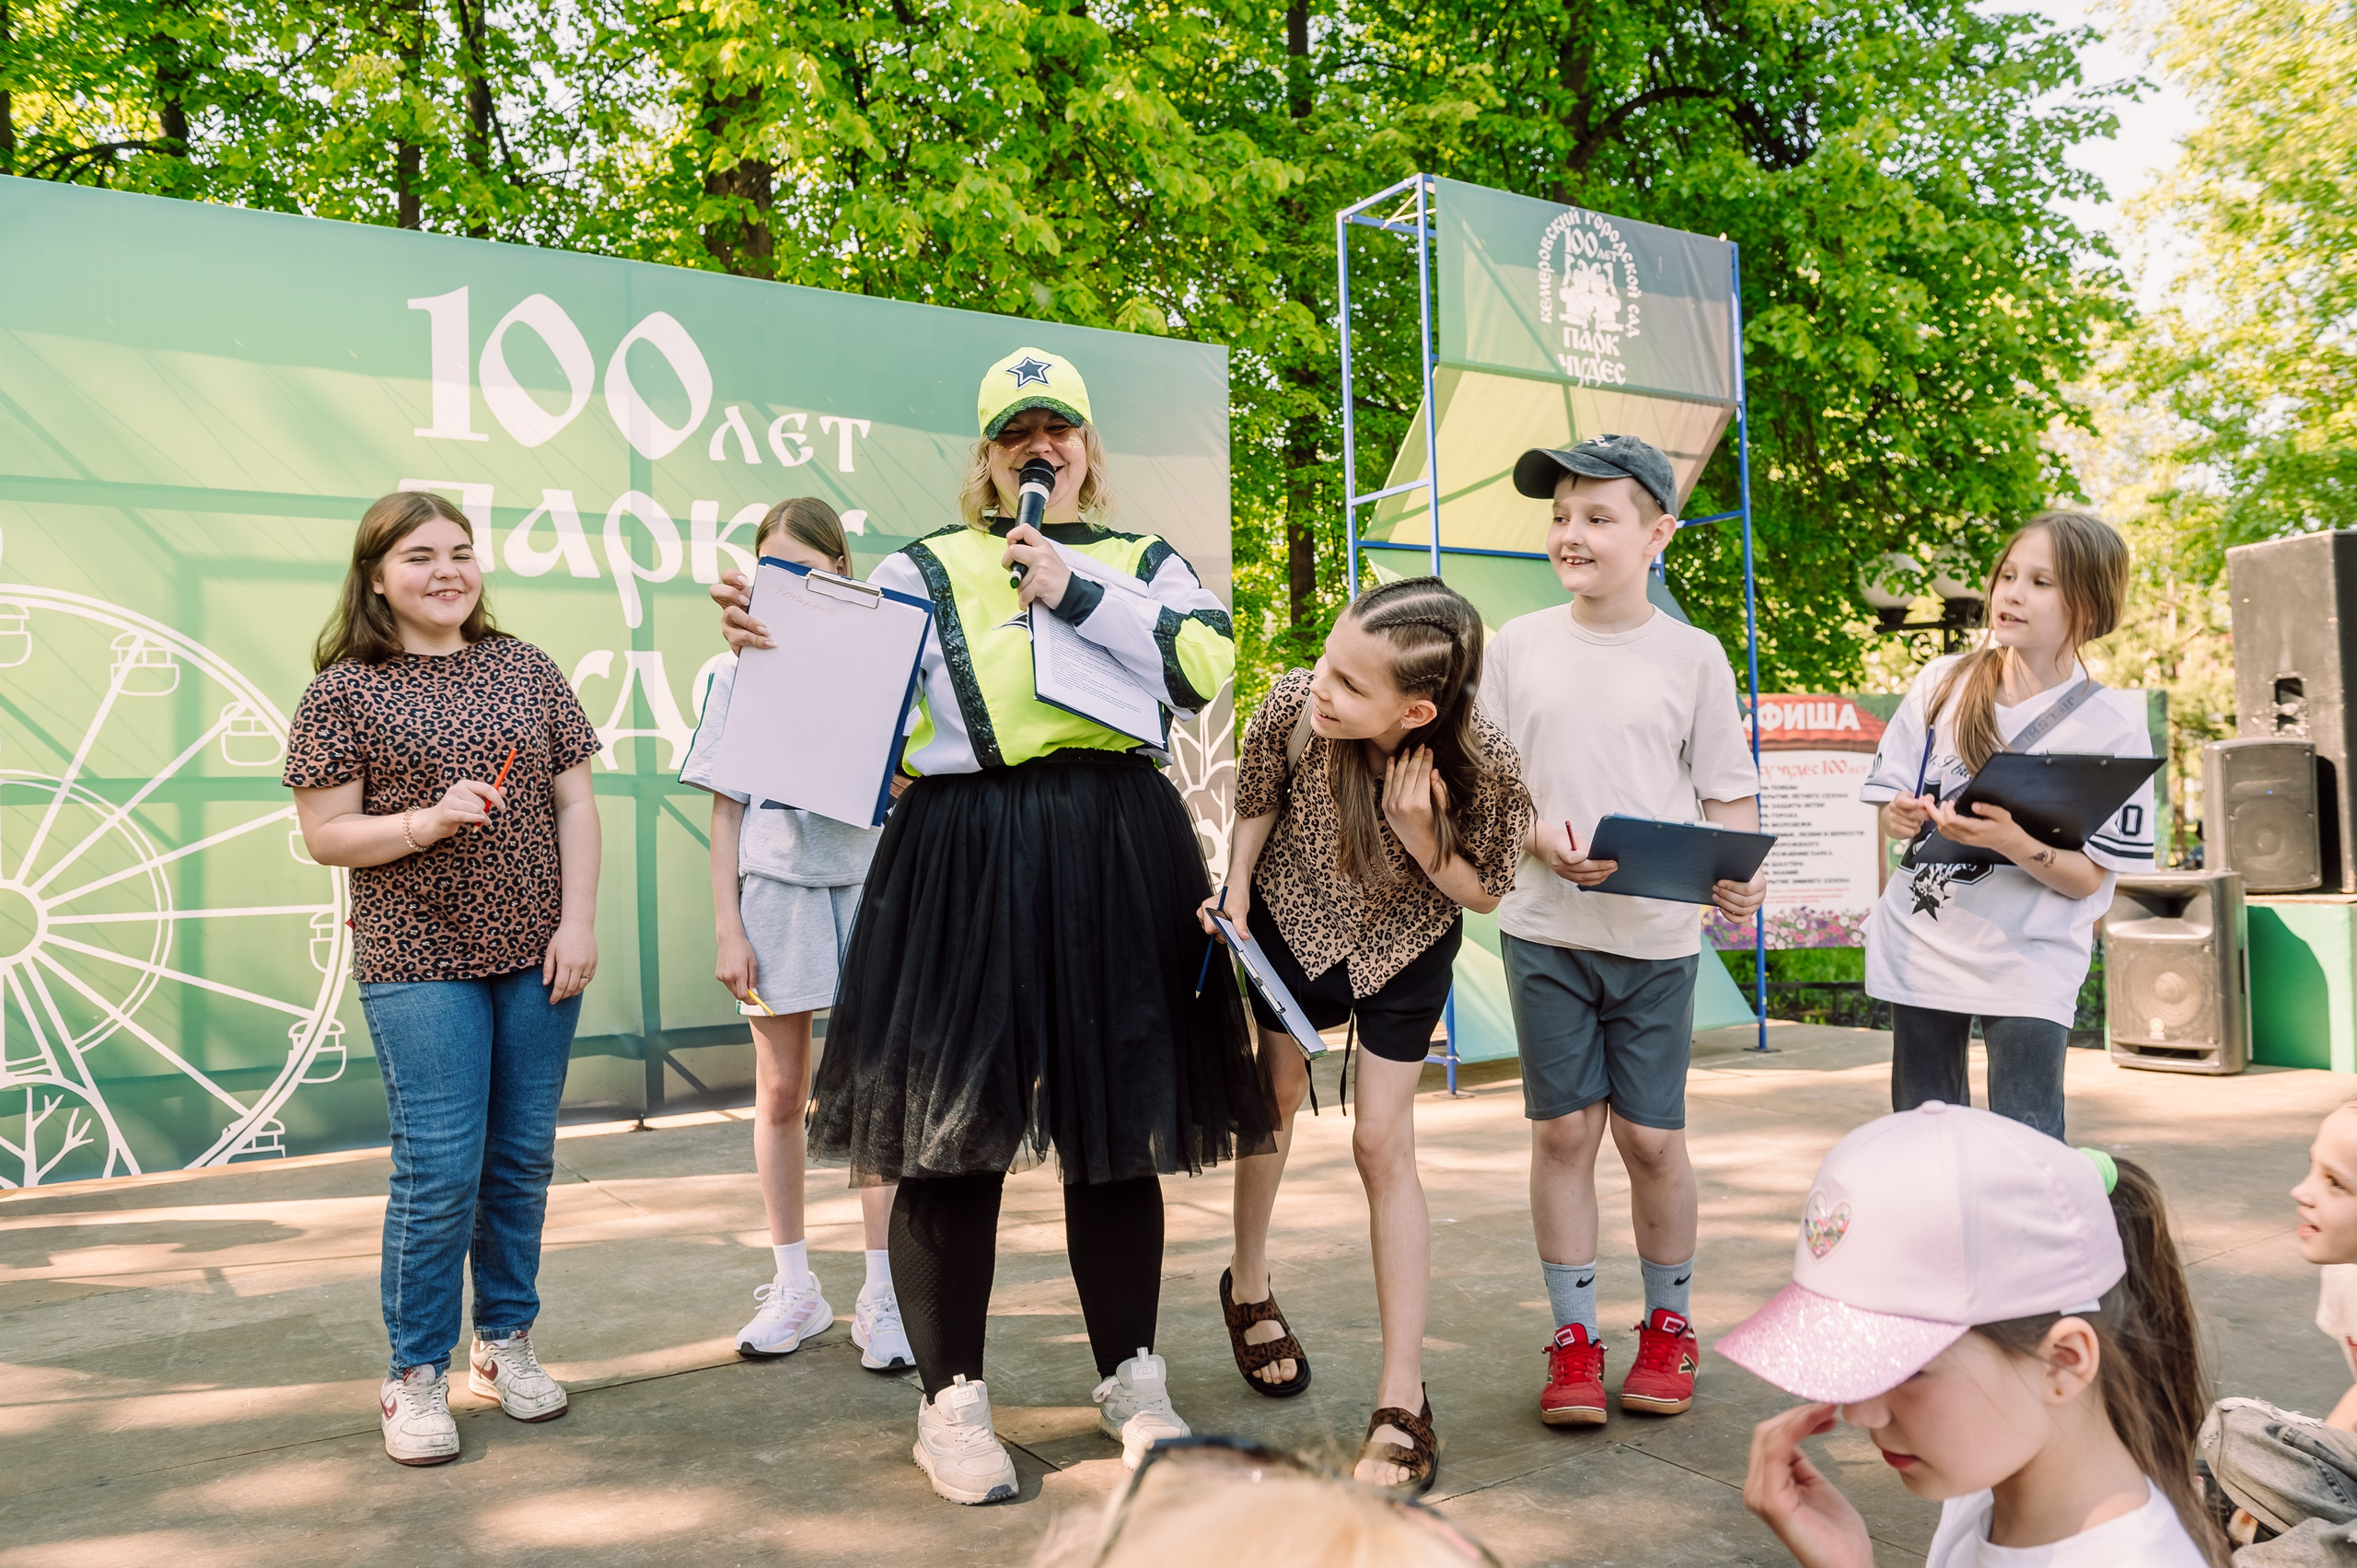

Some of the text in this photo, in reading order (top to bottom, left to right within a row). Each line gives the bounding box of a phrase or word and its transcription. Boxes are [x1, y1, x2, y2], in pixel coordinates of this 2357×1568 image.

[1564, 227, 1618, 262] 100 ЛЕТ
[1538, 206, 1643, 338] КЕМЕРОВСКИЙ ГОРОДСКОЙ САД
[1563, 327, 1621, 363] ПАРК
[407, 285, 871, 472] 100 ЛЕТ
[1557, 353, 1627, 388] ЧУДЕС
[397, 478, 867, 629] ПАРК
[1822, 760, 1848, 775] 100
